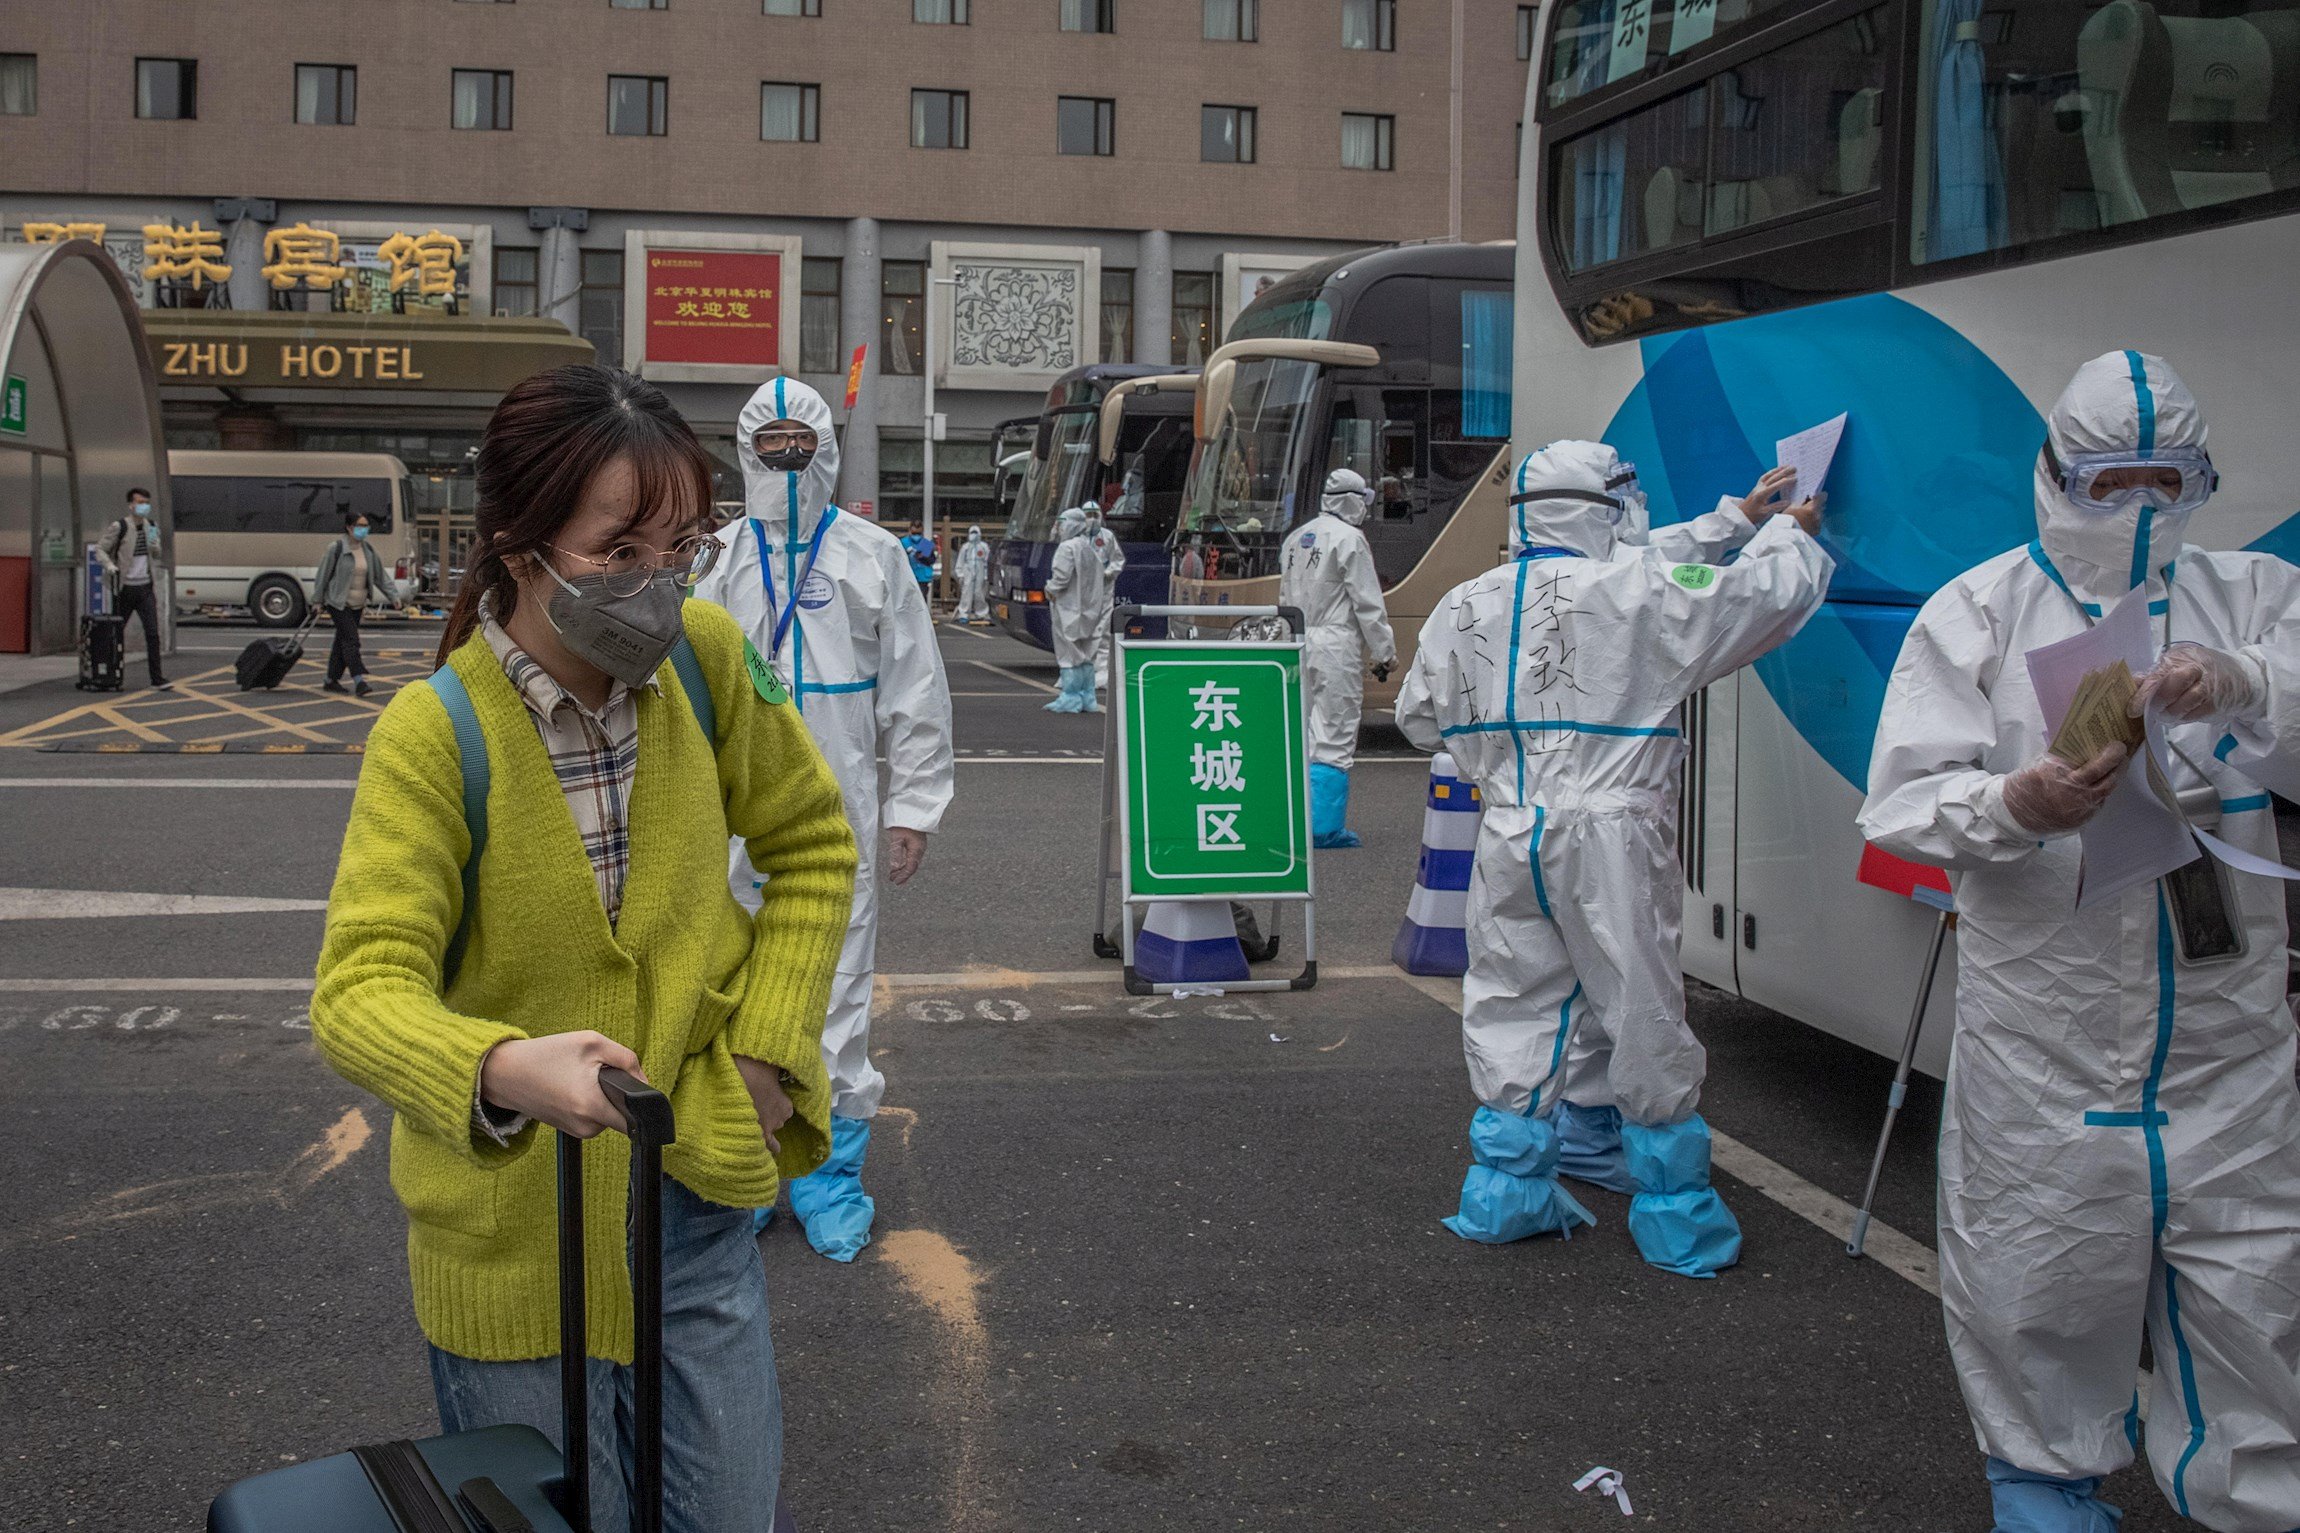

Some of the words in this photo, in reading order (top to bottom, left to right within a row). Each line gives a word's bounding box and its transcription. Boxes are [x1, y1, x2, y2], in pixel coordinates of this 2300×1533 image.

[22, 221, 463, 296] 珠宾馆
[675, 300, 752, 318] 欢迎您
[163, 343, 249, 375] ZHU
[281, 345, 424, 380] HOTEL
[602, 627, 619, 640] 3M
[1188, 680, 1247, 851] 东城区
